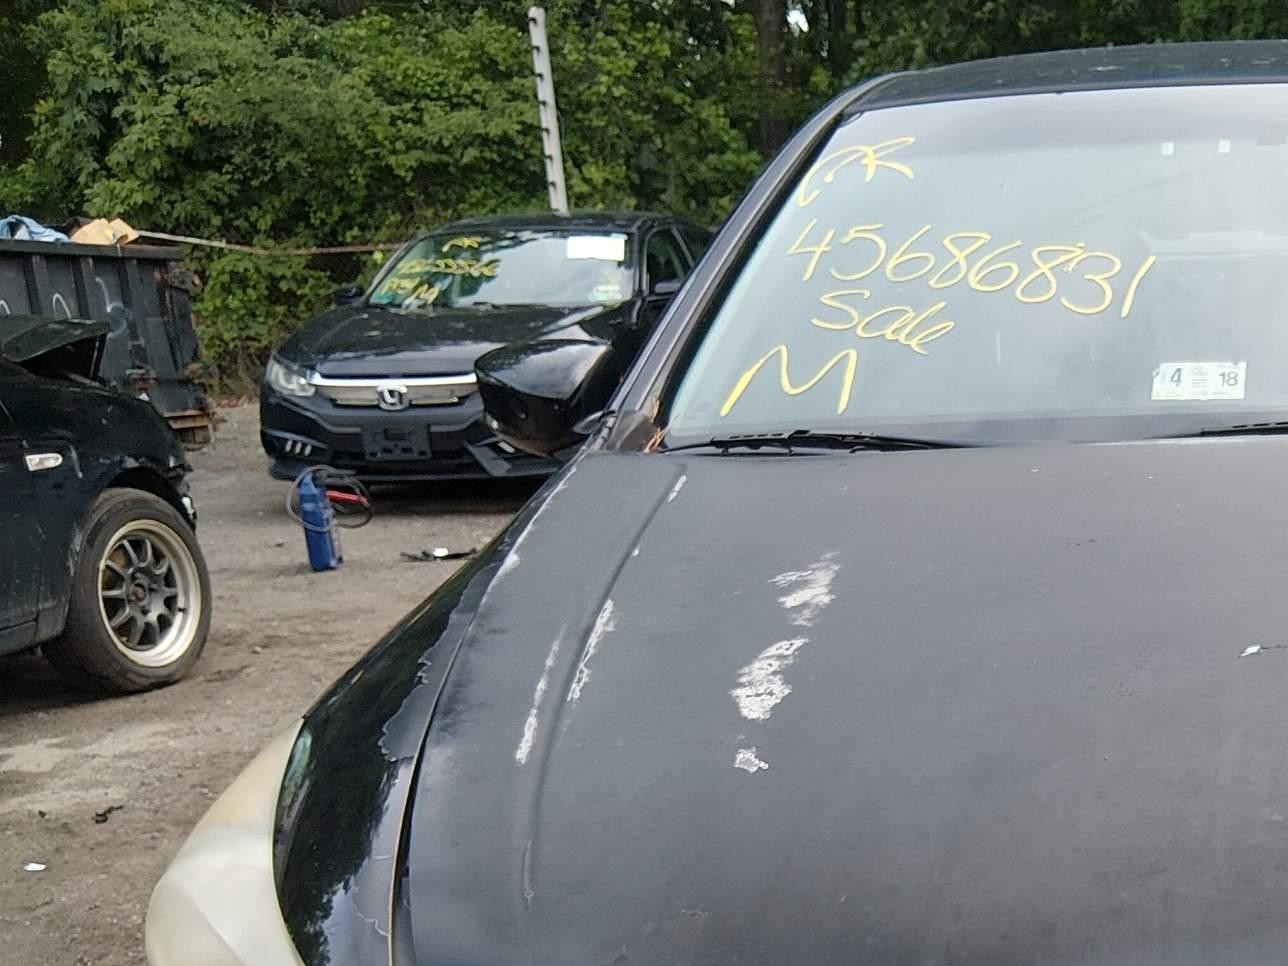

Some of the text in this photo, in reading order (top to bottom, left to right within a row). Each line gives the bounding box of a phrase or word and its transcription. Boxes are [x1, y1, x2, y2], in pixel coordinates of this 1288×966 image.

[787, 218, 1157, 319] 45686831
[1169, 366, 1184, 388] 4
[1218, 370, 1240, 388] 18
